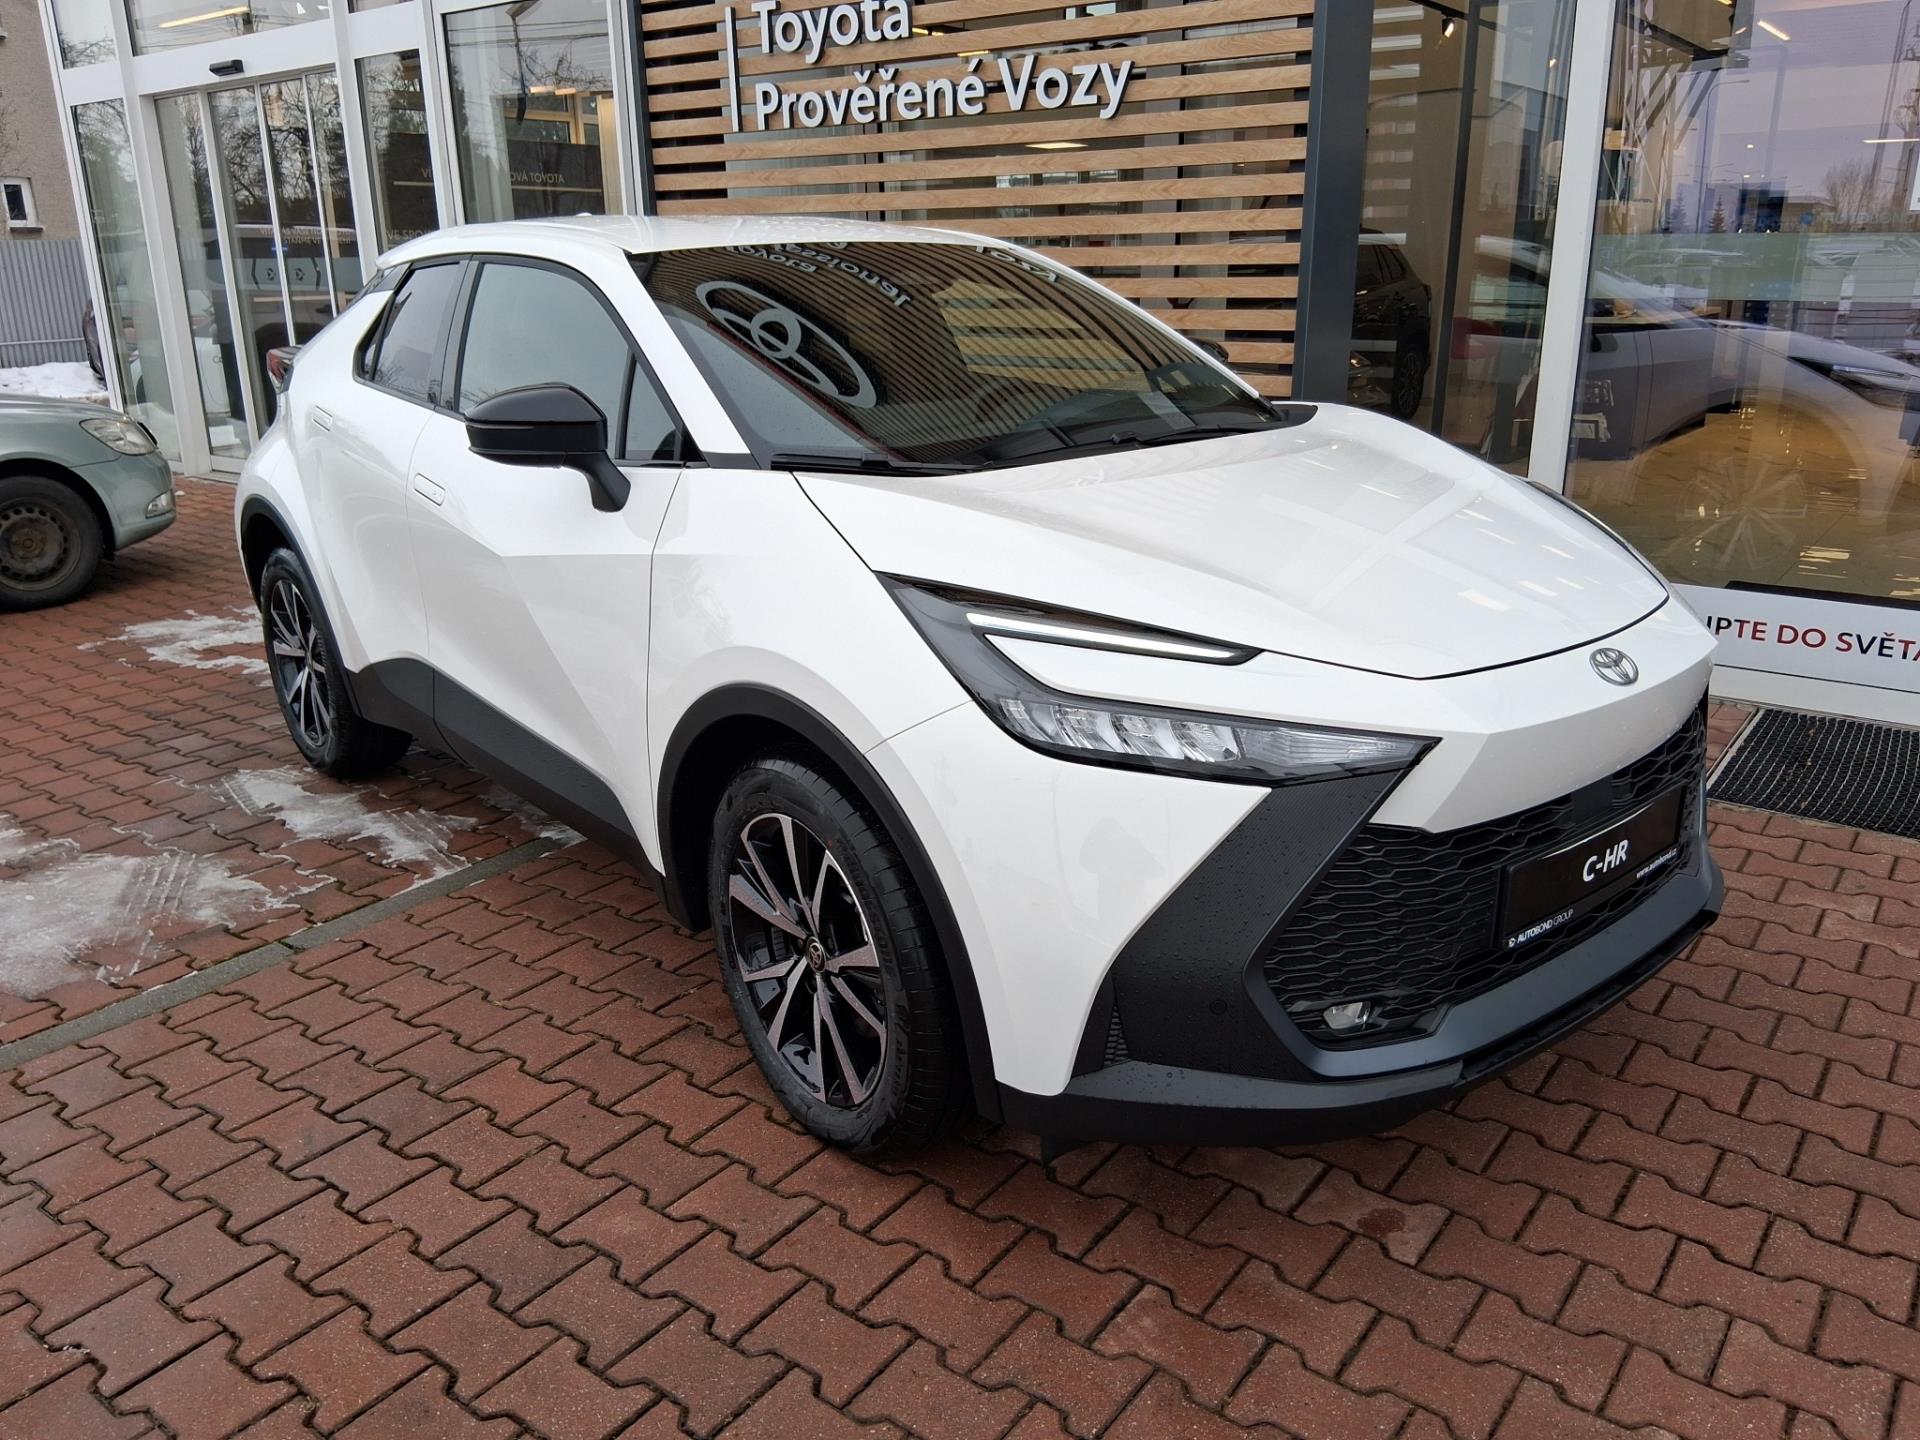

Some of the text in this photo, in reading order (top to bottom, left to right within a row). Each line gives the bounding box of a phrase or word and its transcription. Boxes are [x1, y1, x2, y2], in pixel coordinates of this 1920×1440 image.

[752, 0, 910, 64] Toyota
[755, 54, 1133, 131] Prověřené Vozy
[530, 171, 566, 183] TOYOTA
[1776, 624, 1827, 649] DO
[1582, 838, 1629, 883] C-HR
[1517, 919, 1553, 944] AUTOBOND
[1553, 908, 1574, 925] GROUP
